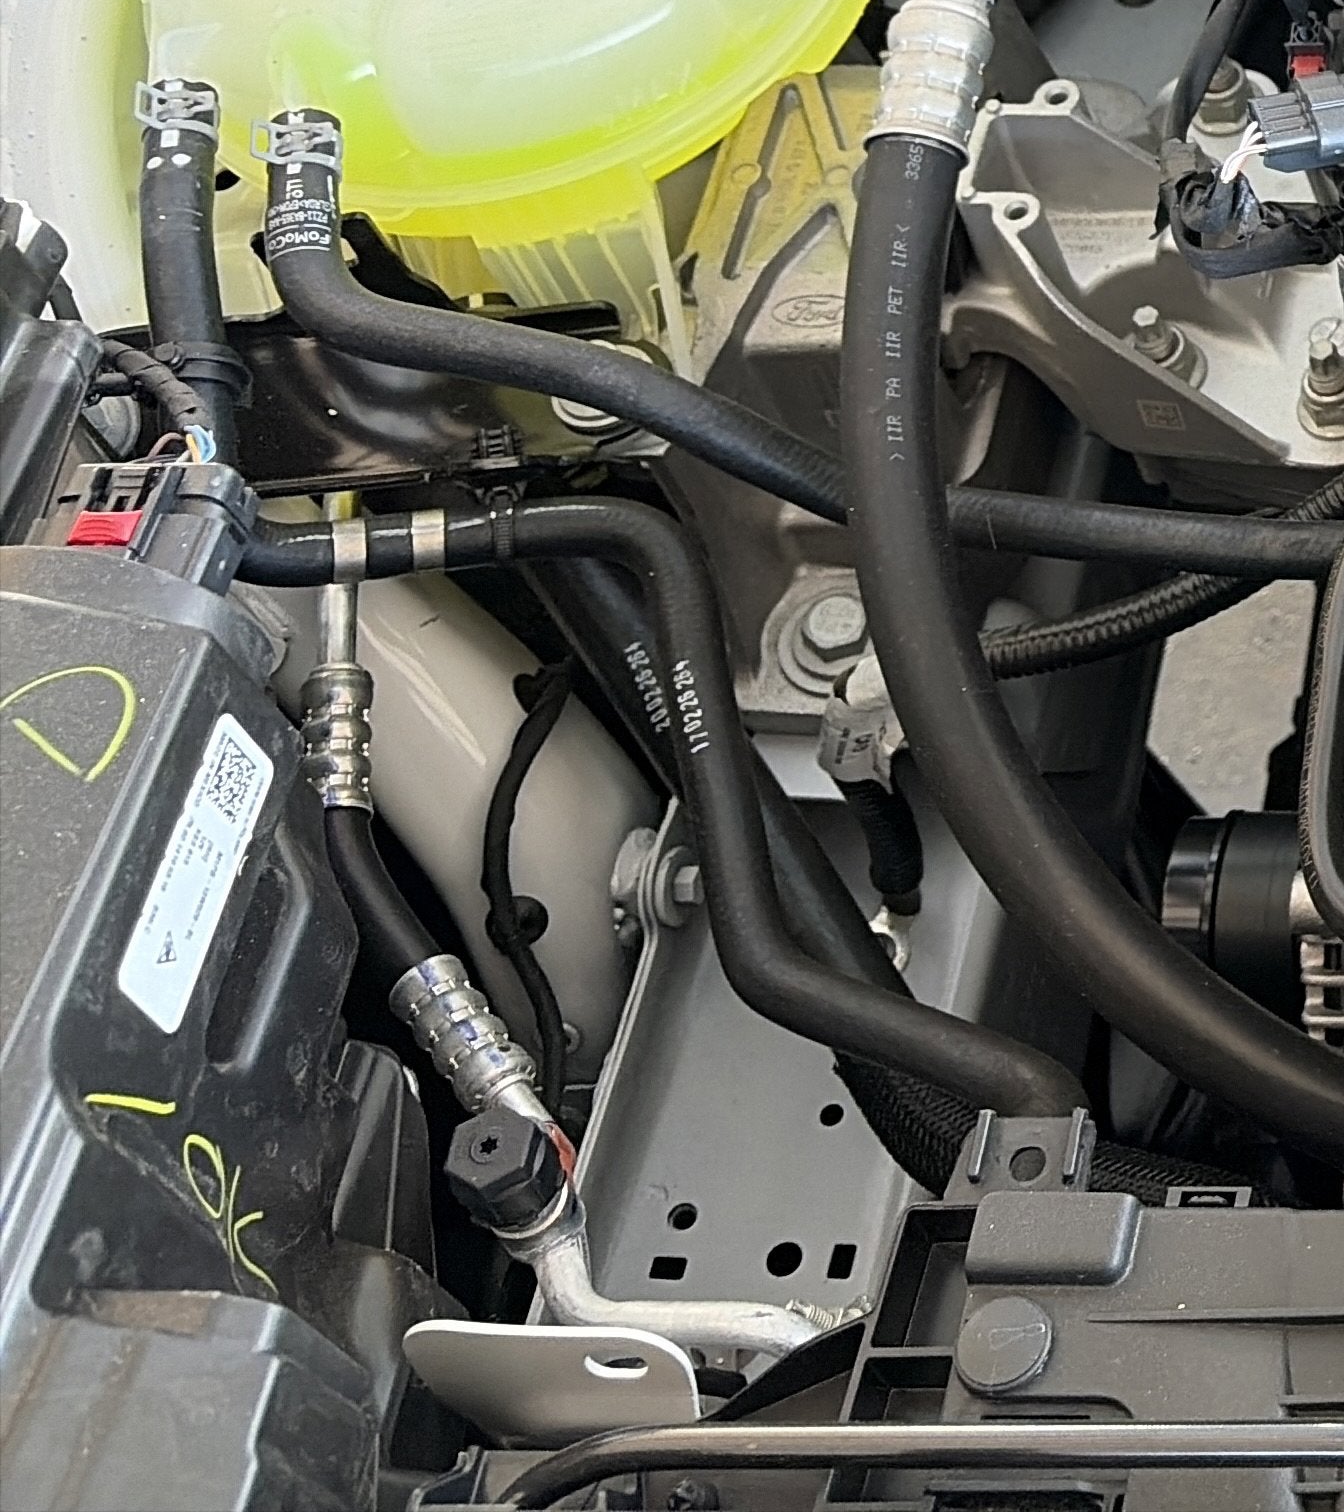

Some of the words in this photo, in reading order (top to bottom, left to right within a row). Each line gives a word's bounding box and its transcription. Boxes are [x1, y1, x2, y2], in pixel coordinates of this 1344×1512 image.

[269, 230, 331, 251] FoMoCo
[887, 286, 904, 317] PET
[886, 376, 901, 402] PA
